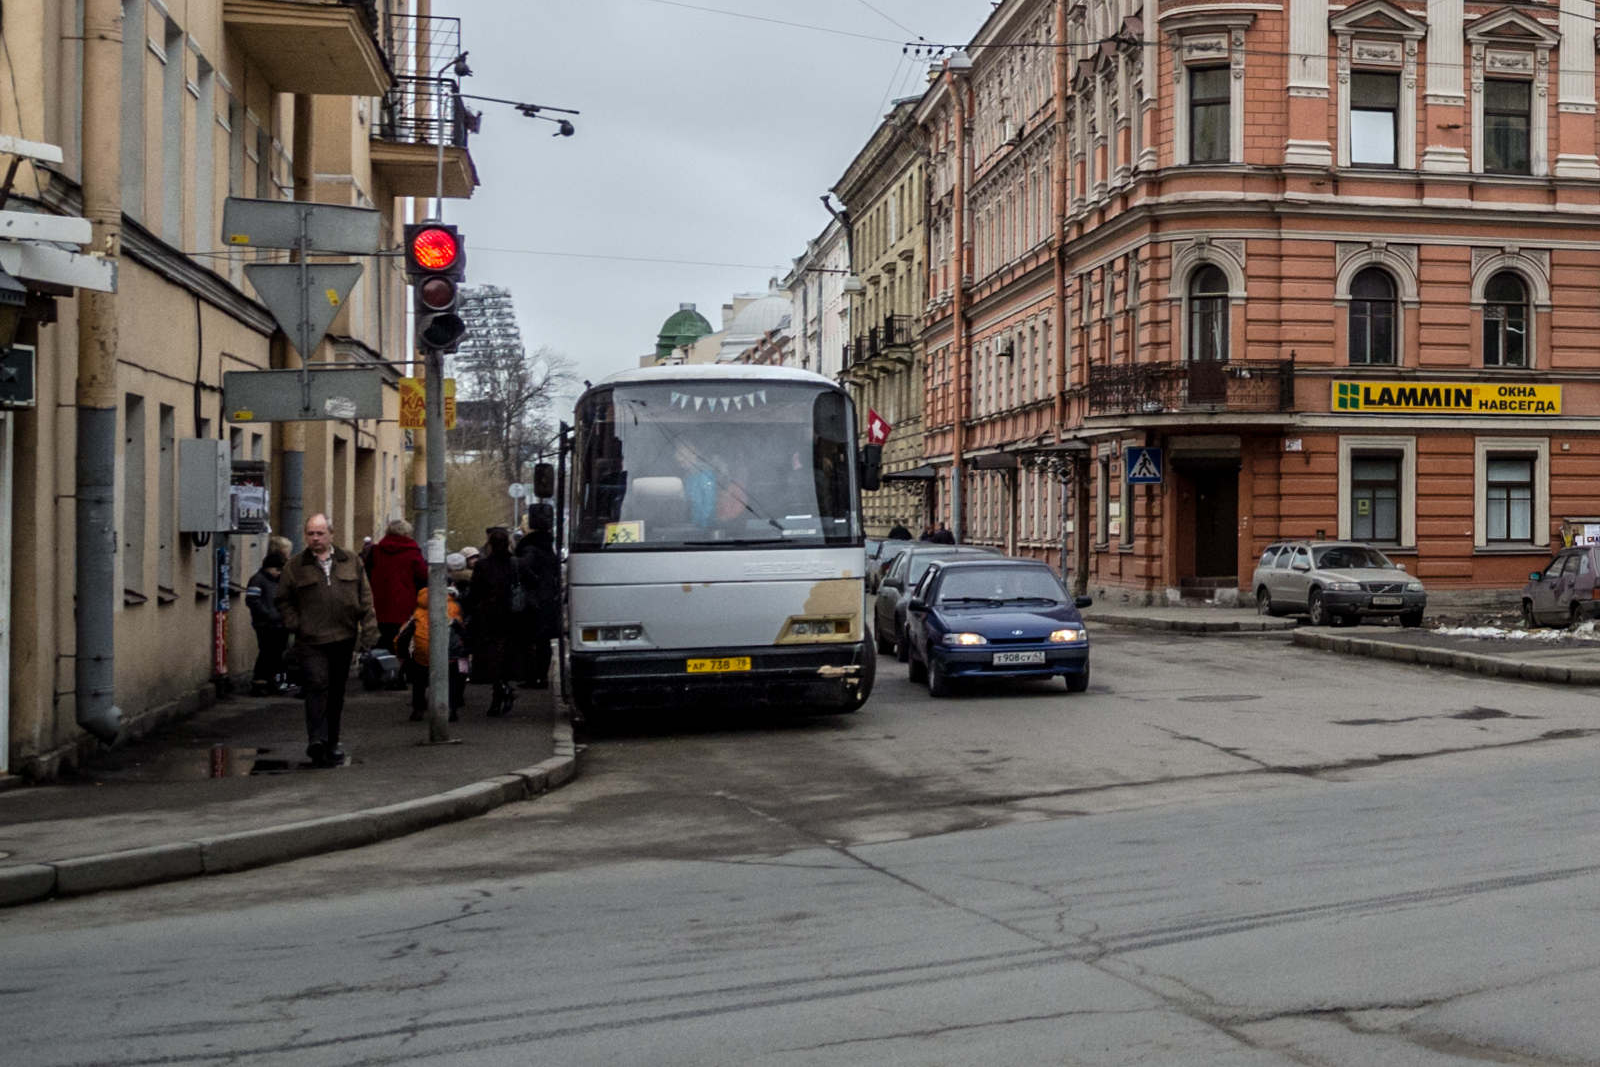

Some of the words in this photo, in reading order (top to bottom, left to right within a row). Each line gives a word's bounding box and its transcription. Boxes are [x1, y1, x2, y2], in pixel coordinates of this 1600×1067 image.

[1363, 387, 1472, 407] LAMMIN
[1498, 386, 1536, 397] ОКНА
[402, 396, 453, 410] КАЕ
[1479, 399, 1555, 412] НАВСЕГДА
[692, 662, 705, 671] АР
[710, 657, 730, 670] 738
